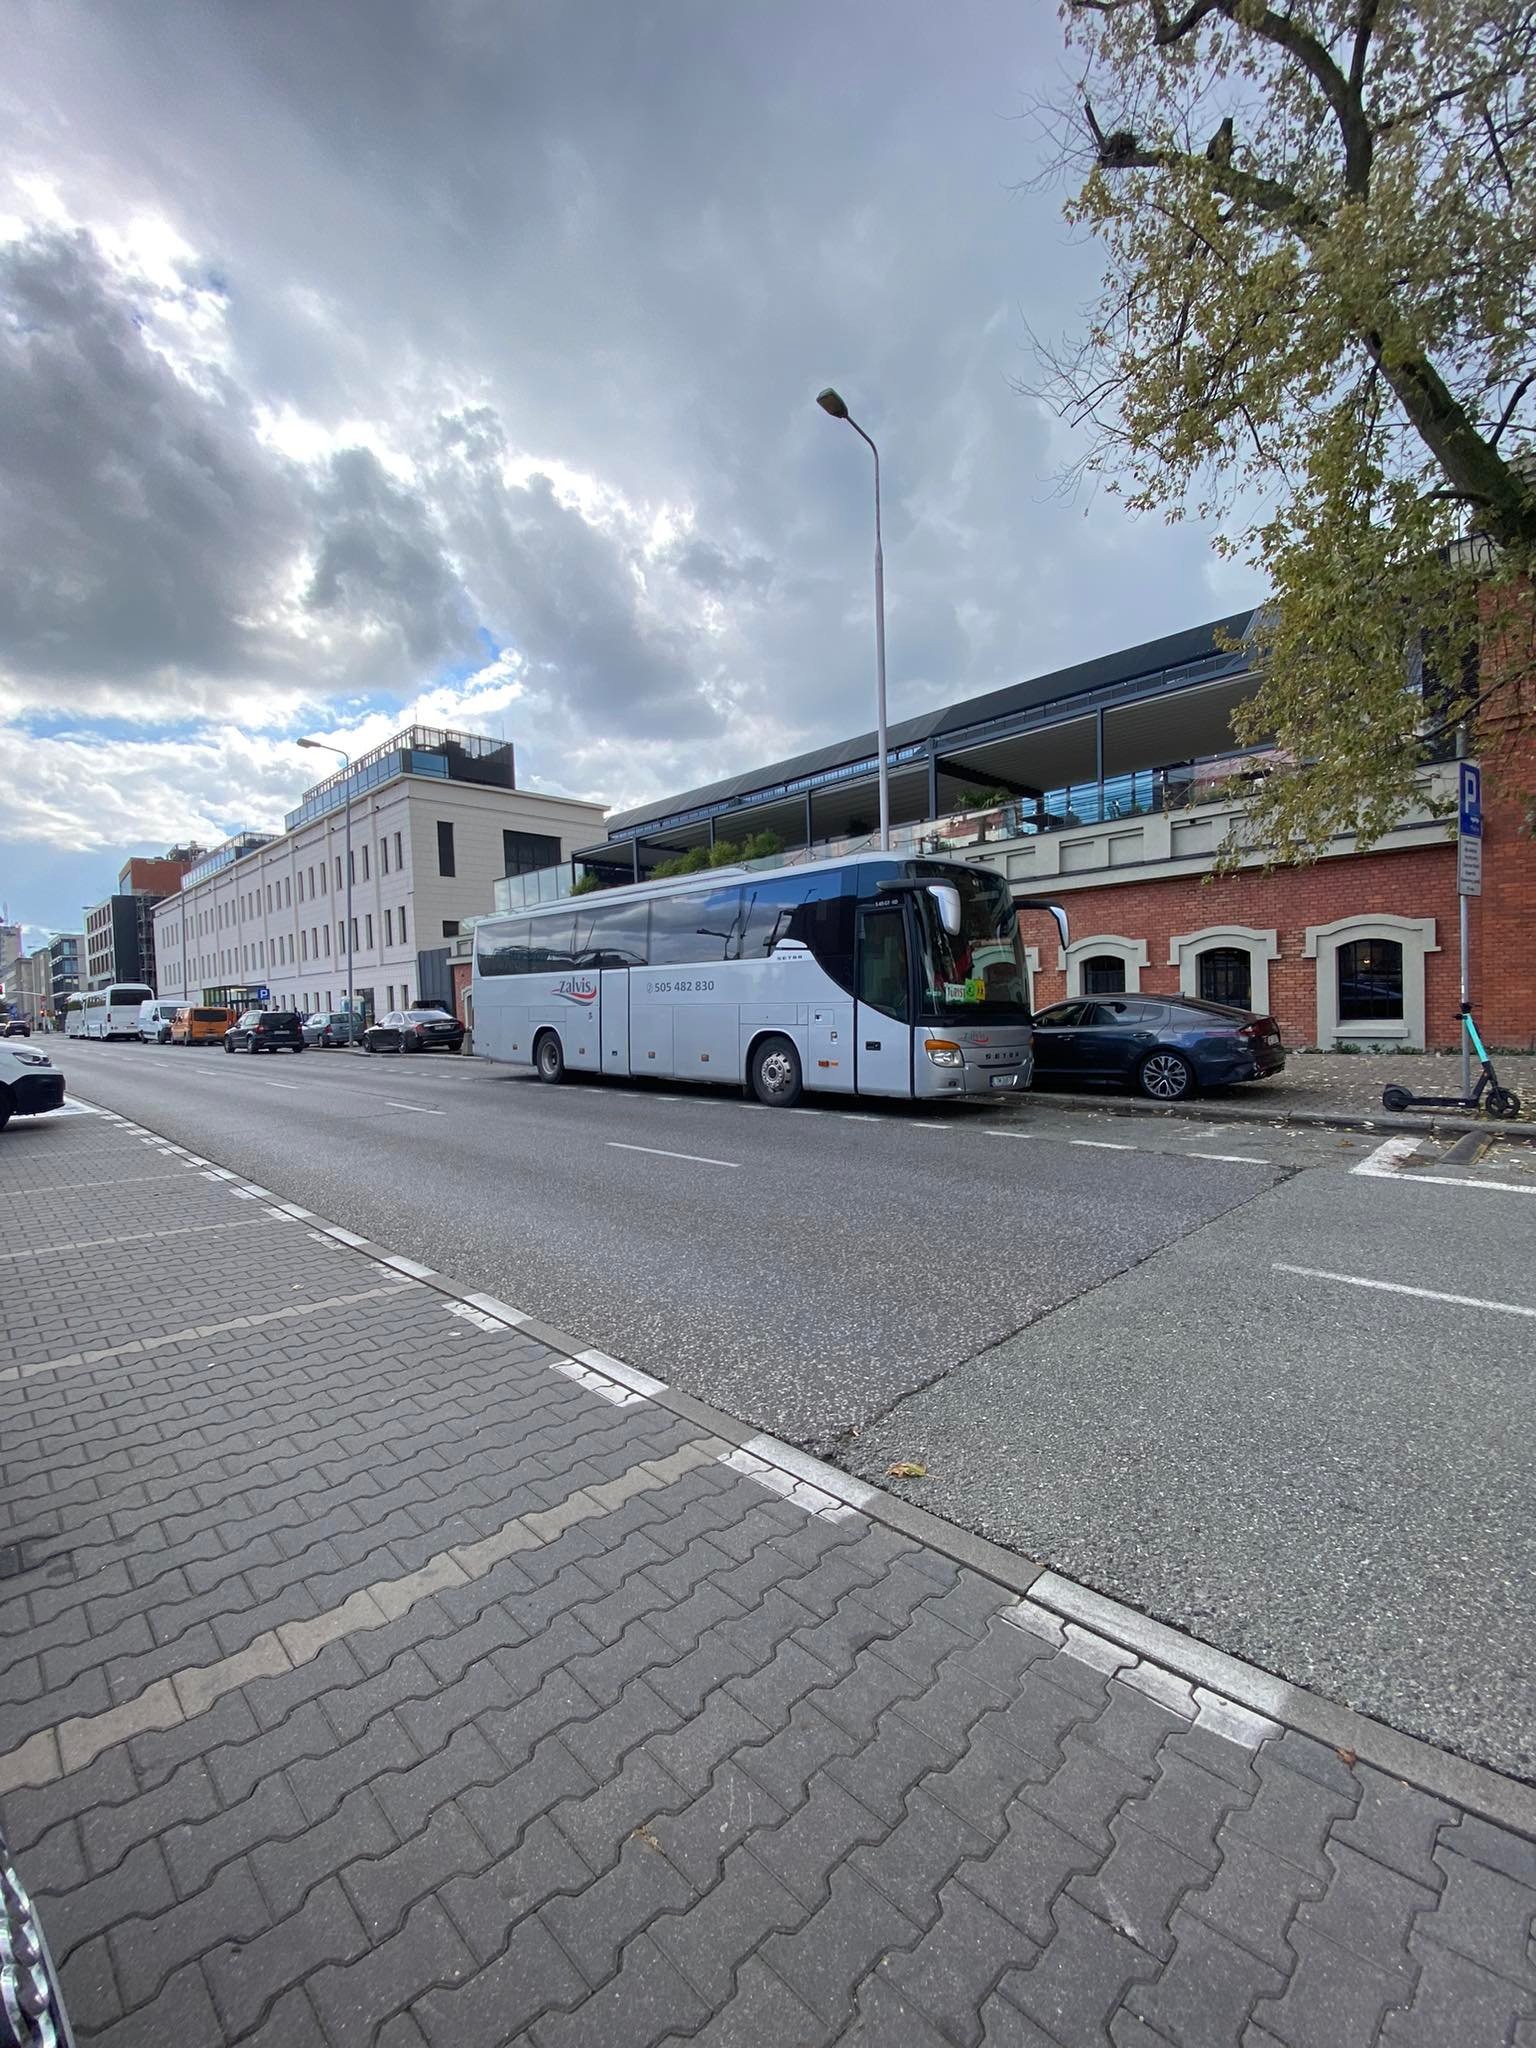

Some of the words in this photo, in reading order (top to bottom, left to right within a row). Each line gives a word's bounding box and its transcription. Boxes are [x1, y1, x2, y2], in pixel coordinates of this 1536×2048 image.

[1465, 770, 1477, 813] P
[654, 982, 672, 992] 505
[674, 981, 692, 991] 482
[695, 980, 714, 991] 830
[260, 989, 268, 998] P
